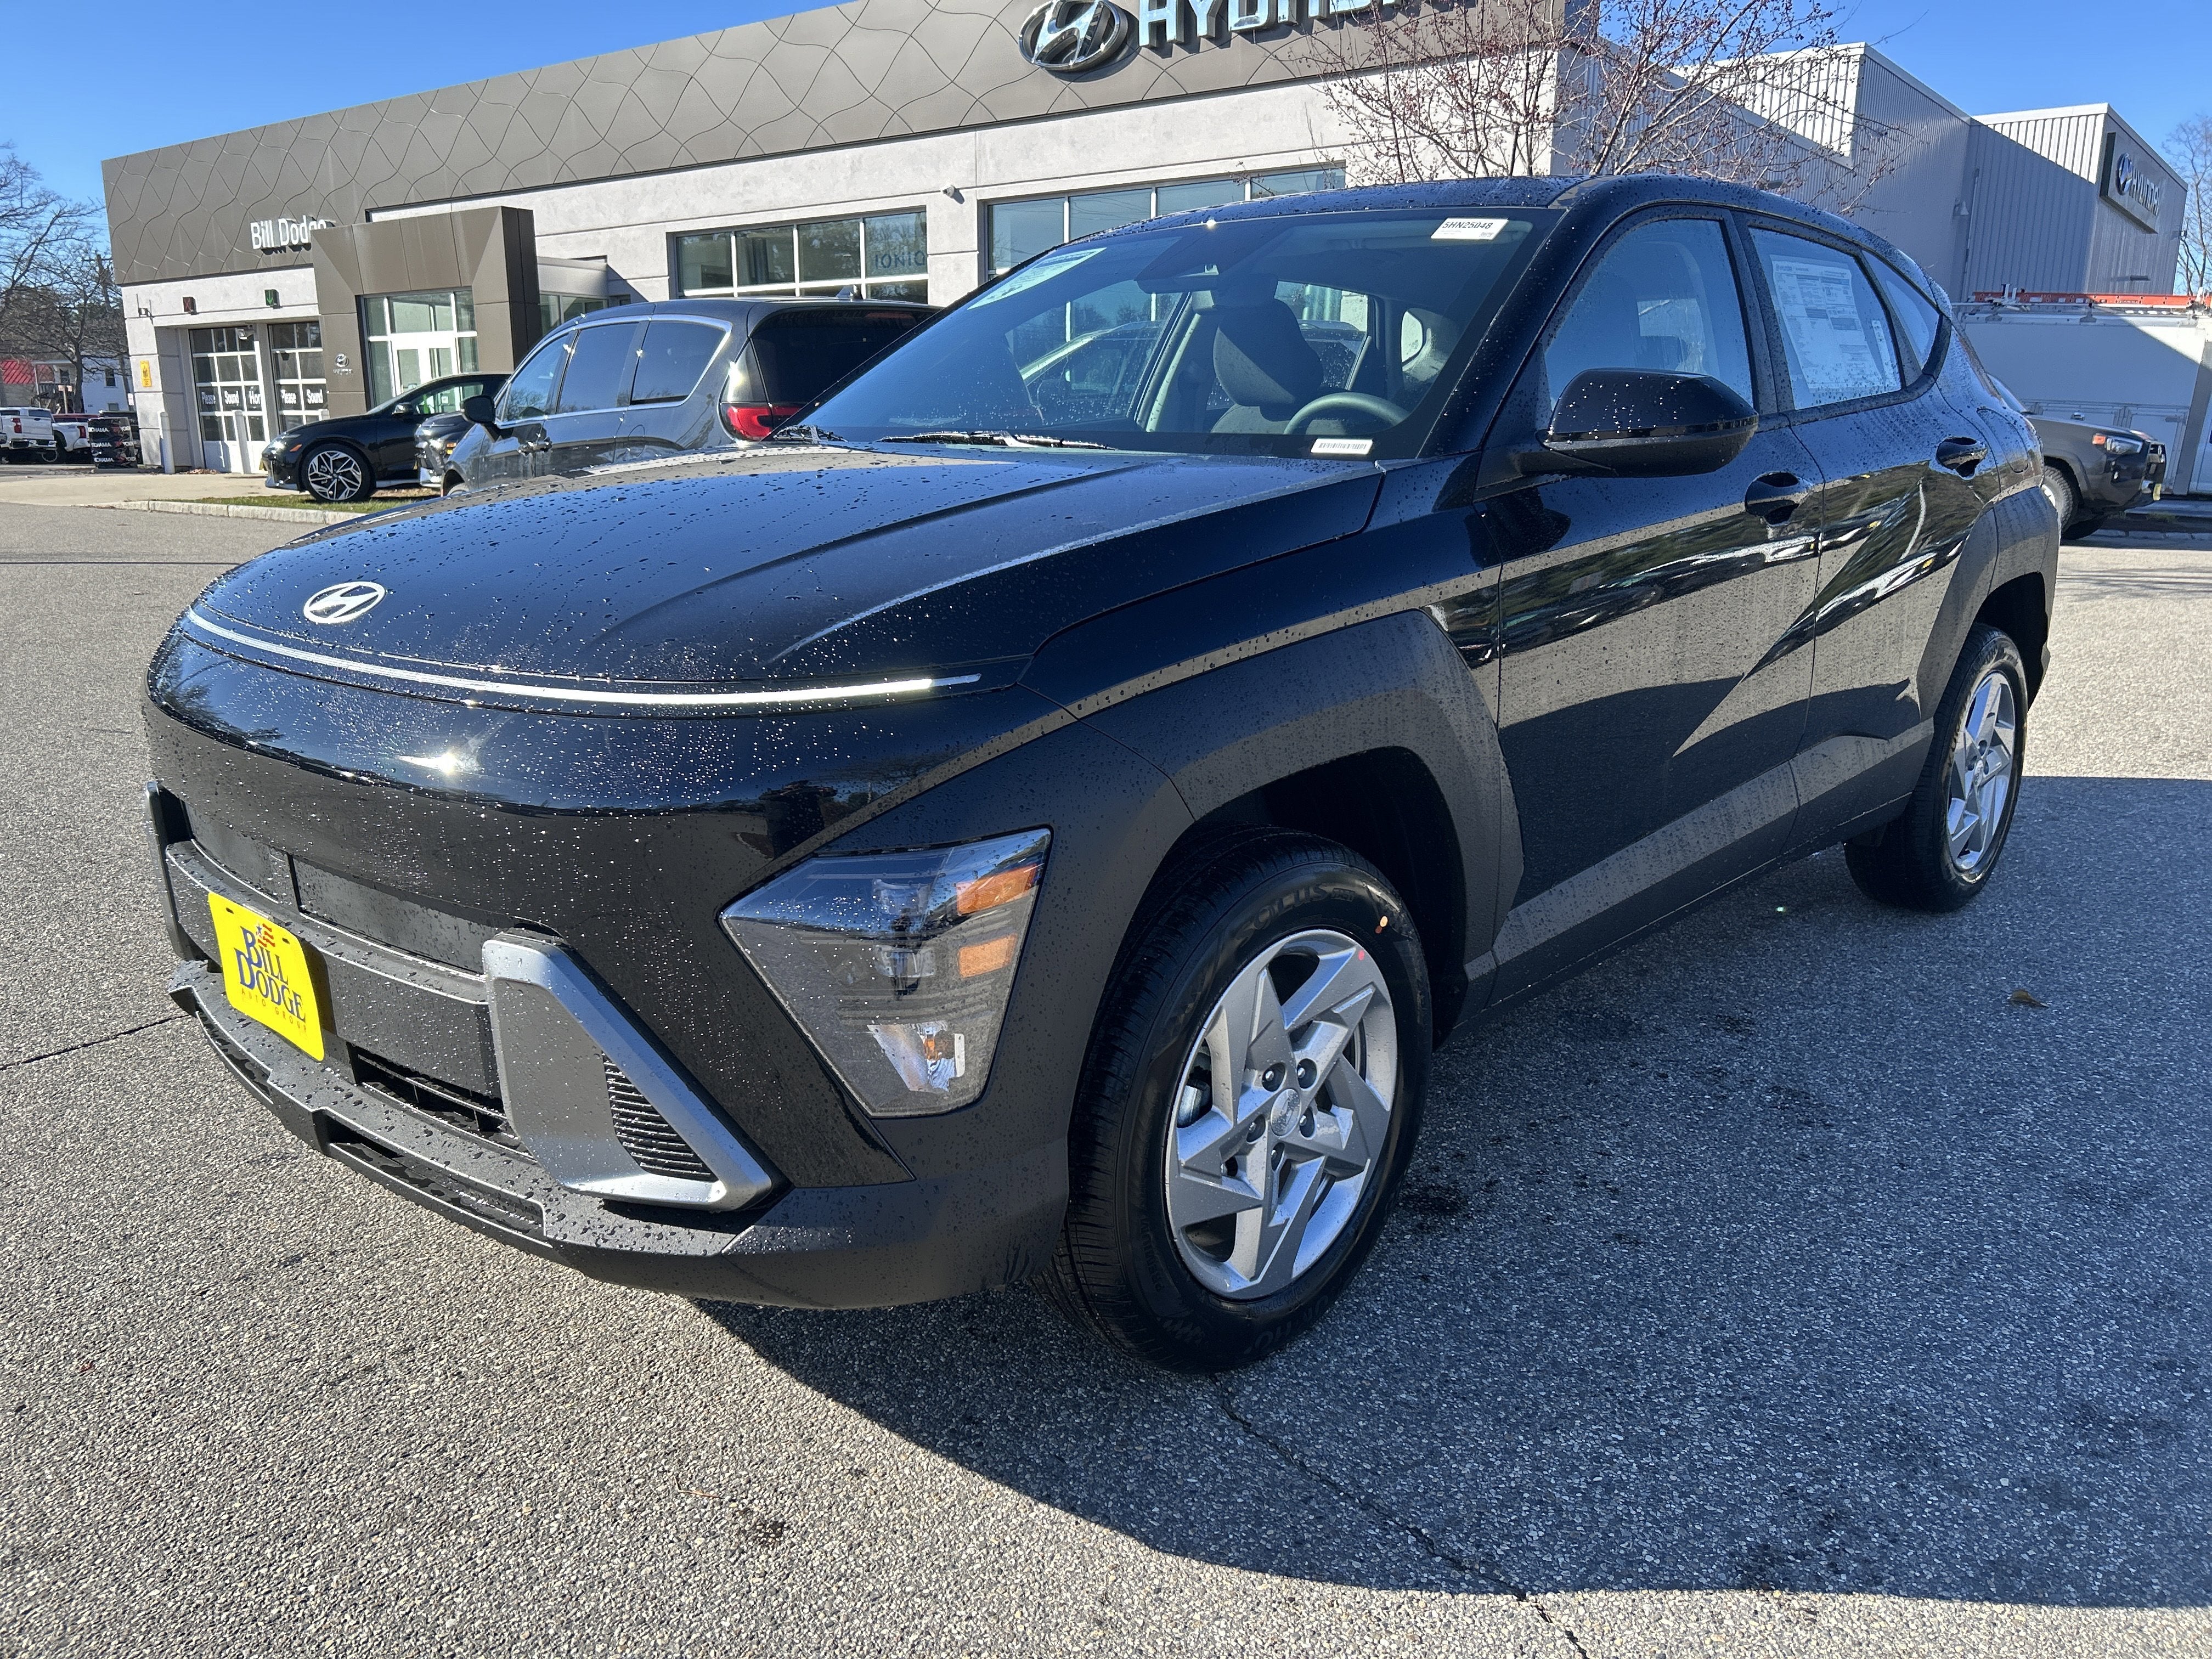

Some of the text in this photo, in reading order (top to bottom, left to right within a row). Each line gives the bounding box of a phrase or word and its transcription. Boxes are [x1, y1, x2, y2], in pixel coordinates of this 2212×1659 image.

[250, 220, 274, 250] Bill
[874, 250, 926, 269] IONIQ
[201, 390, 262, 405] Please Sound Hor
[280, 388, 324, 404] Please Sound
[1234, 882, 1328, 948] SOLUS
[240, 926, 288, 985] BILL
[234, 947, 306, 1022] DODGE
[240, 988, 308, 1034] AUTO GROUP
